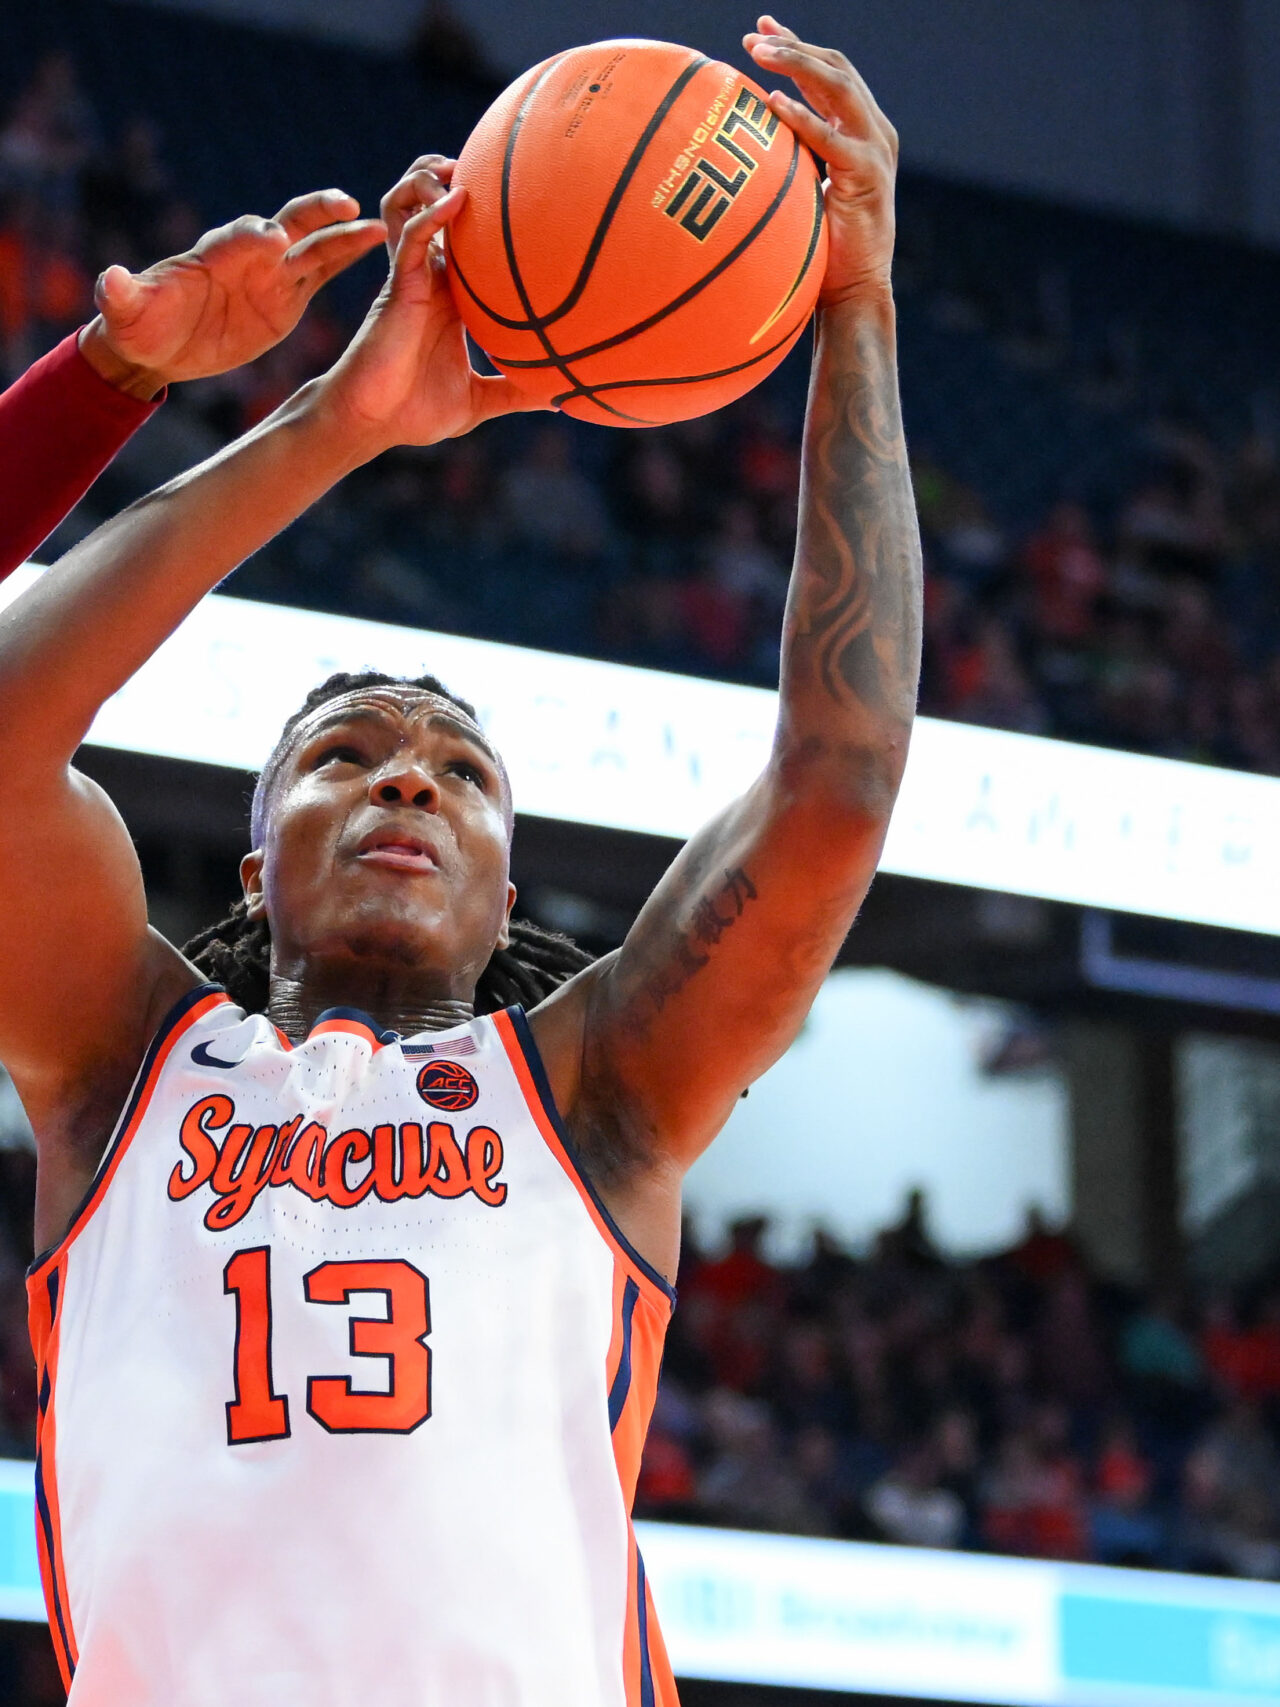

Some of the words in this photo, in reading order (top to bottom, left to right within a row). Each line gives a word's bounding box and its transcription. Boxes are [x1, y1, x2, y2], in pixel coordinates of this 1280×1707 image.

[663, 85, 781, 244] ELITE
[427, 1077, 471, 1090] ACC
[168, 1094, 507, 1231] Syracuse
[223, 1245, 432, 1446] 13
